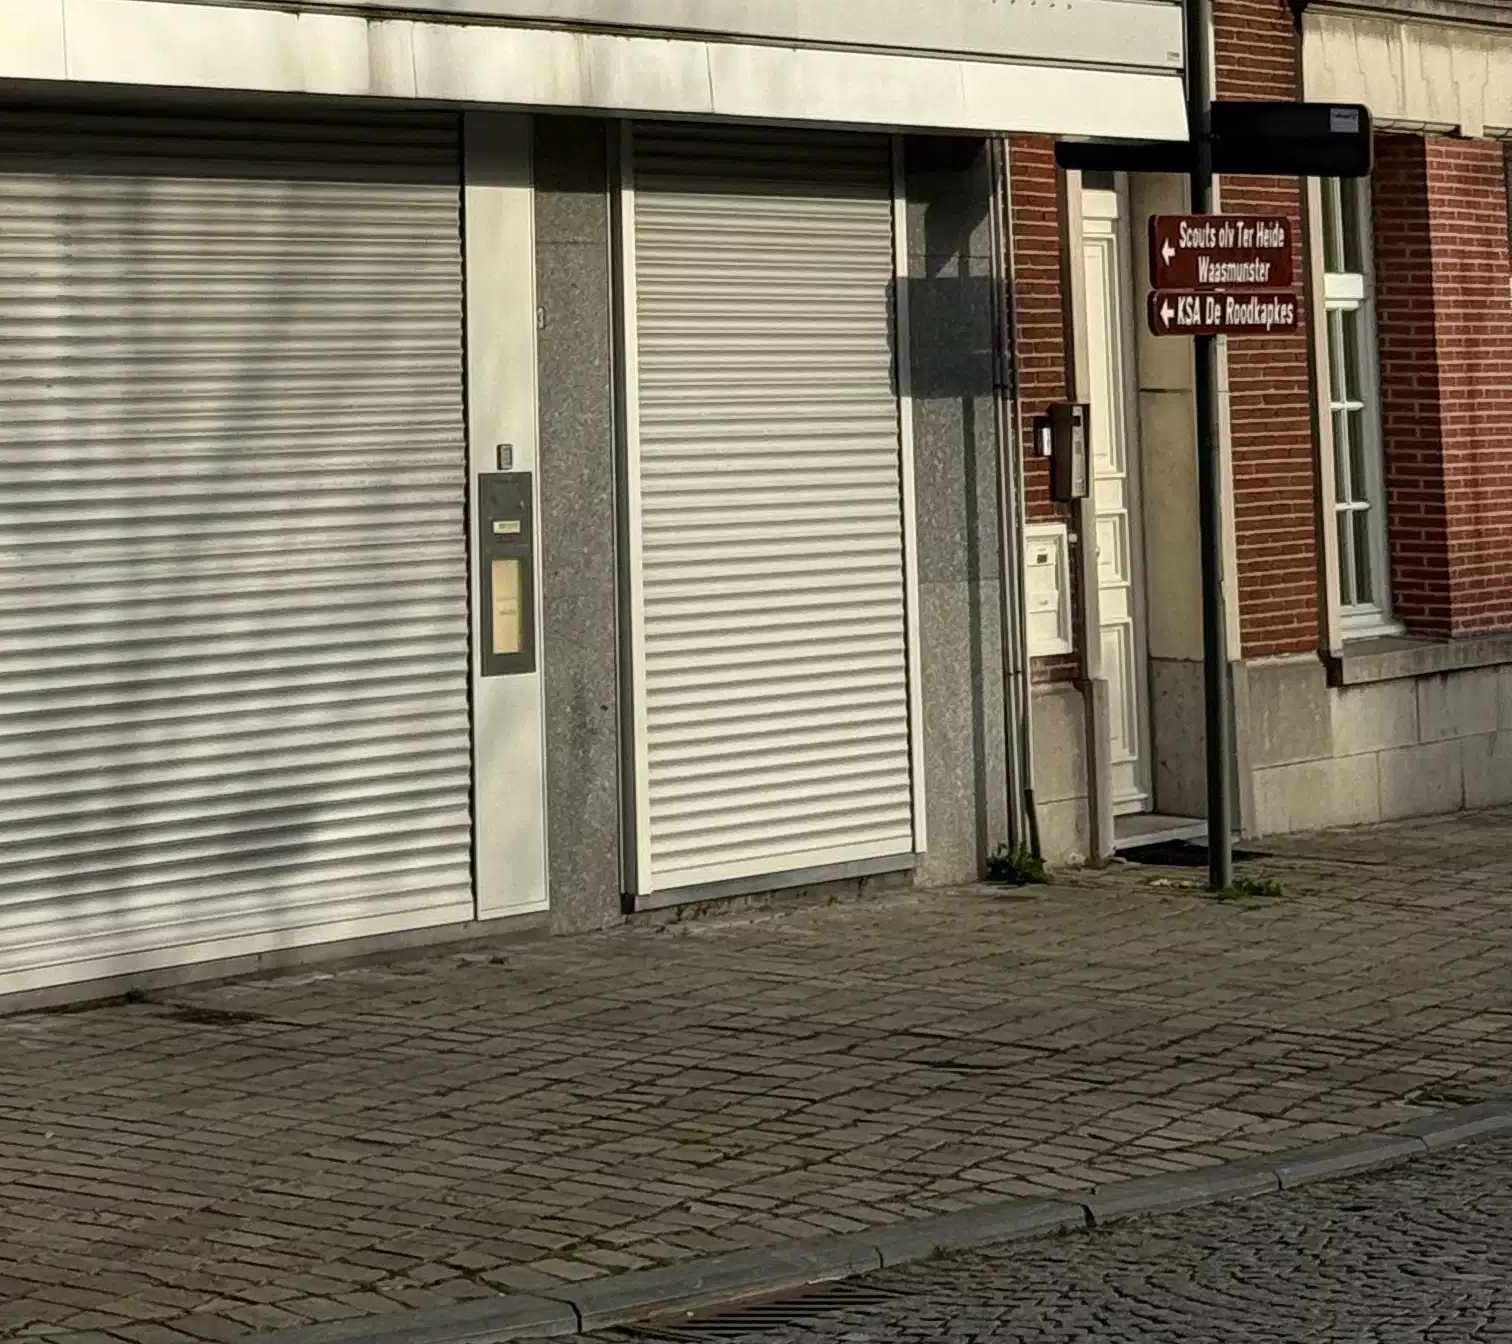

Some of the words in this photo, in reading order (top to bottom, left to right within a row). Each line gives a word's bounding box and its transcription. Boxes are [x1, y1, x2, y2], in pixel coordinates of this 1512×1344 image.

[1179, 220, 1216, 248] Scouts
[1219, 221, 1234, 248] olv
[1237, 221, 1254, 248] Ter
[1256, 220, 1285, 248] Heide
[1198, 256, 1271, 283] Waasmunster
[1177, 296, 1201, 325] KSA
[1205, 296, 1221, 325] De
[1225, 296, 1294, 331] Roodkapkes
